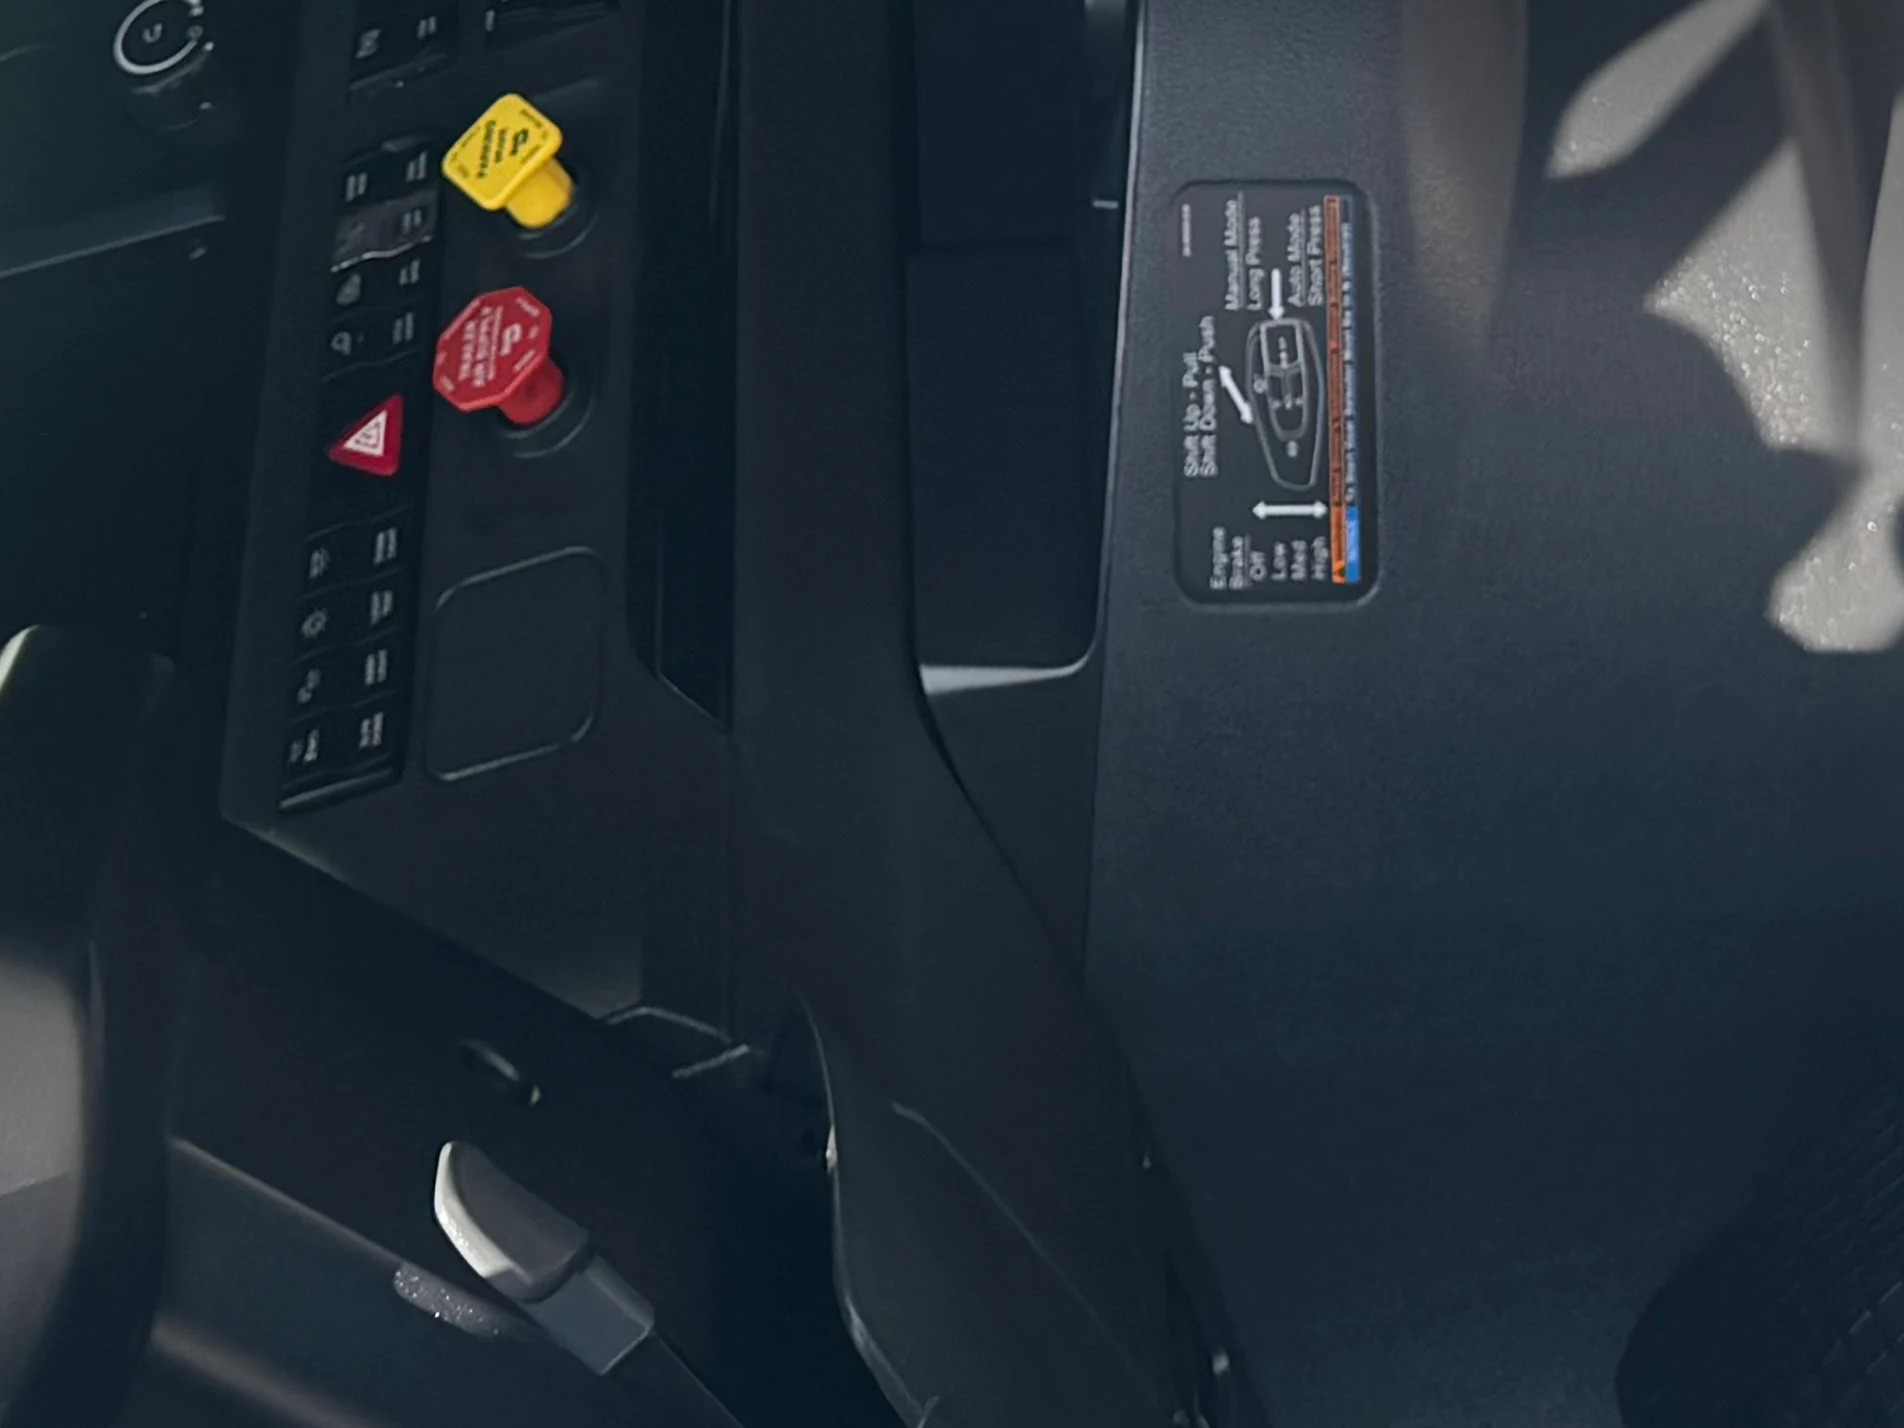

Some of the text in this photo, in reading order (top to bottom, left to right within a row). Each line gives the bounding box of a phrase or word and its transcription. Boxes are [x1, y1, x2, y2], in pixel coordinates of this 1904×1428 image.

[1224, 199, 1238, 310] Manual Mode
[1245, 216, 1265, 310] Long Press
[1287, 213, 1302, 307] Auto Mode
[1306, 205, 1324, 306] Short Press
[1198, 316, 1215, 362] Push
[1182, 352, 1198, 387] Pull
[1183, 404, 1201, 431] Up
[1199, 379, 1216, 430] Down
[1183, 435, 1199, 476] Shift
[1199, 435, 1218, 476] Shift
[1209, 527, 1228, 590] Engine
[1228, 536, 1244, 590] Brake
[1249, 551, 1267, 581] Off
[1271, 542, 1288, 581] Low
[1291, 540, 1307, 580] Med
[1311, 537, 1328, 580] High
